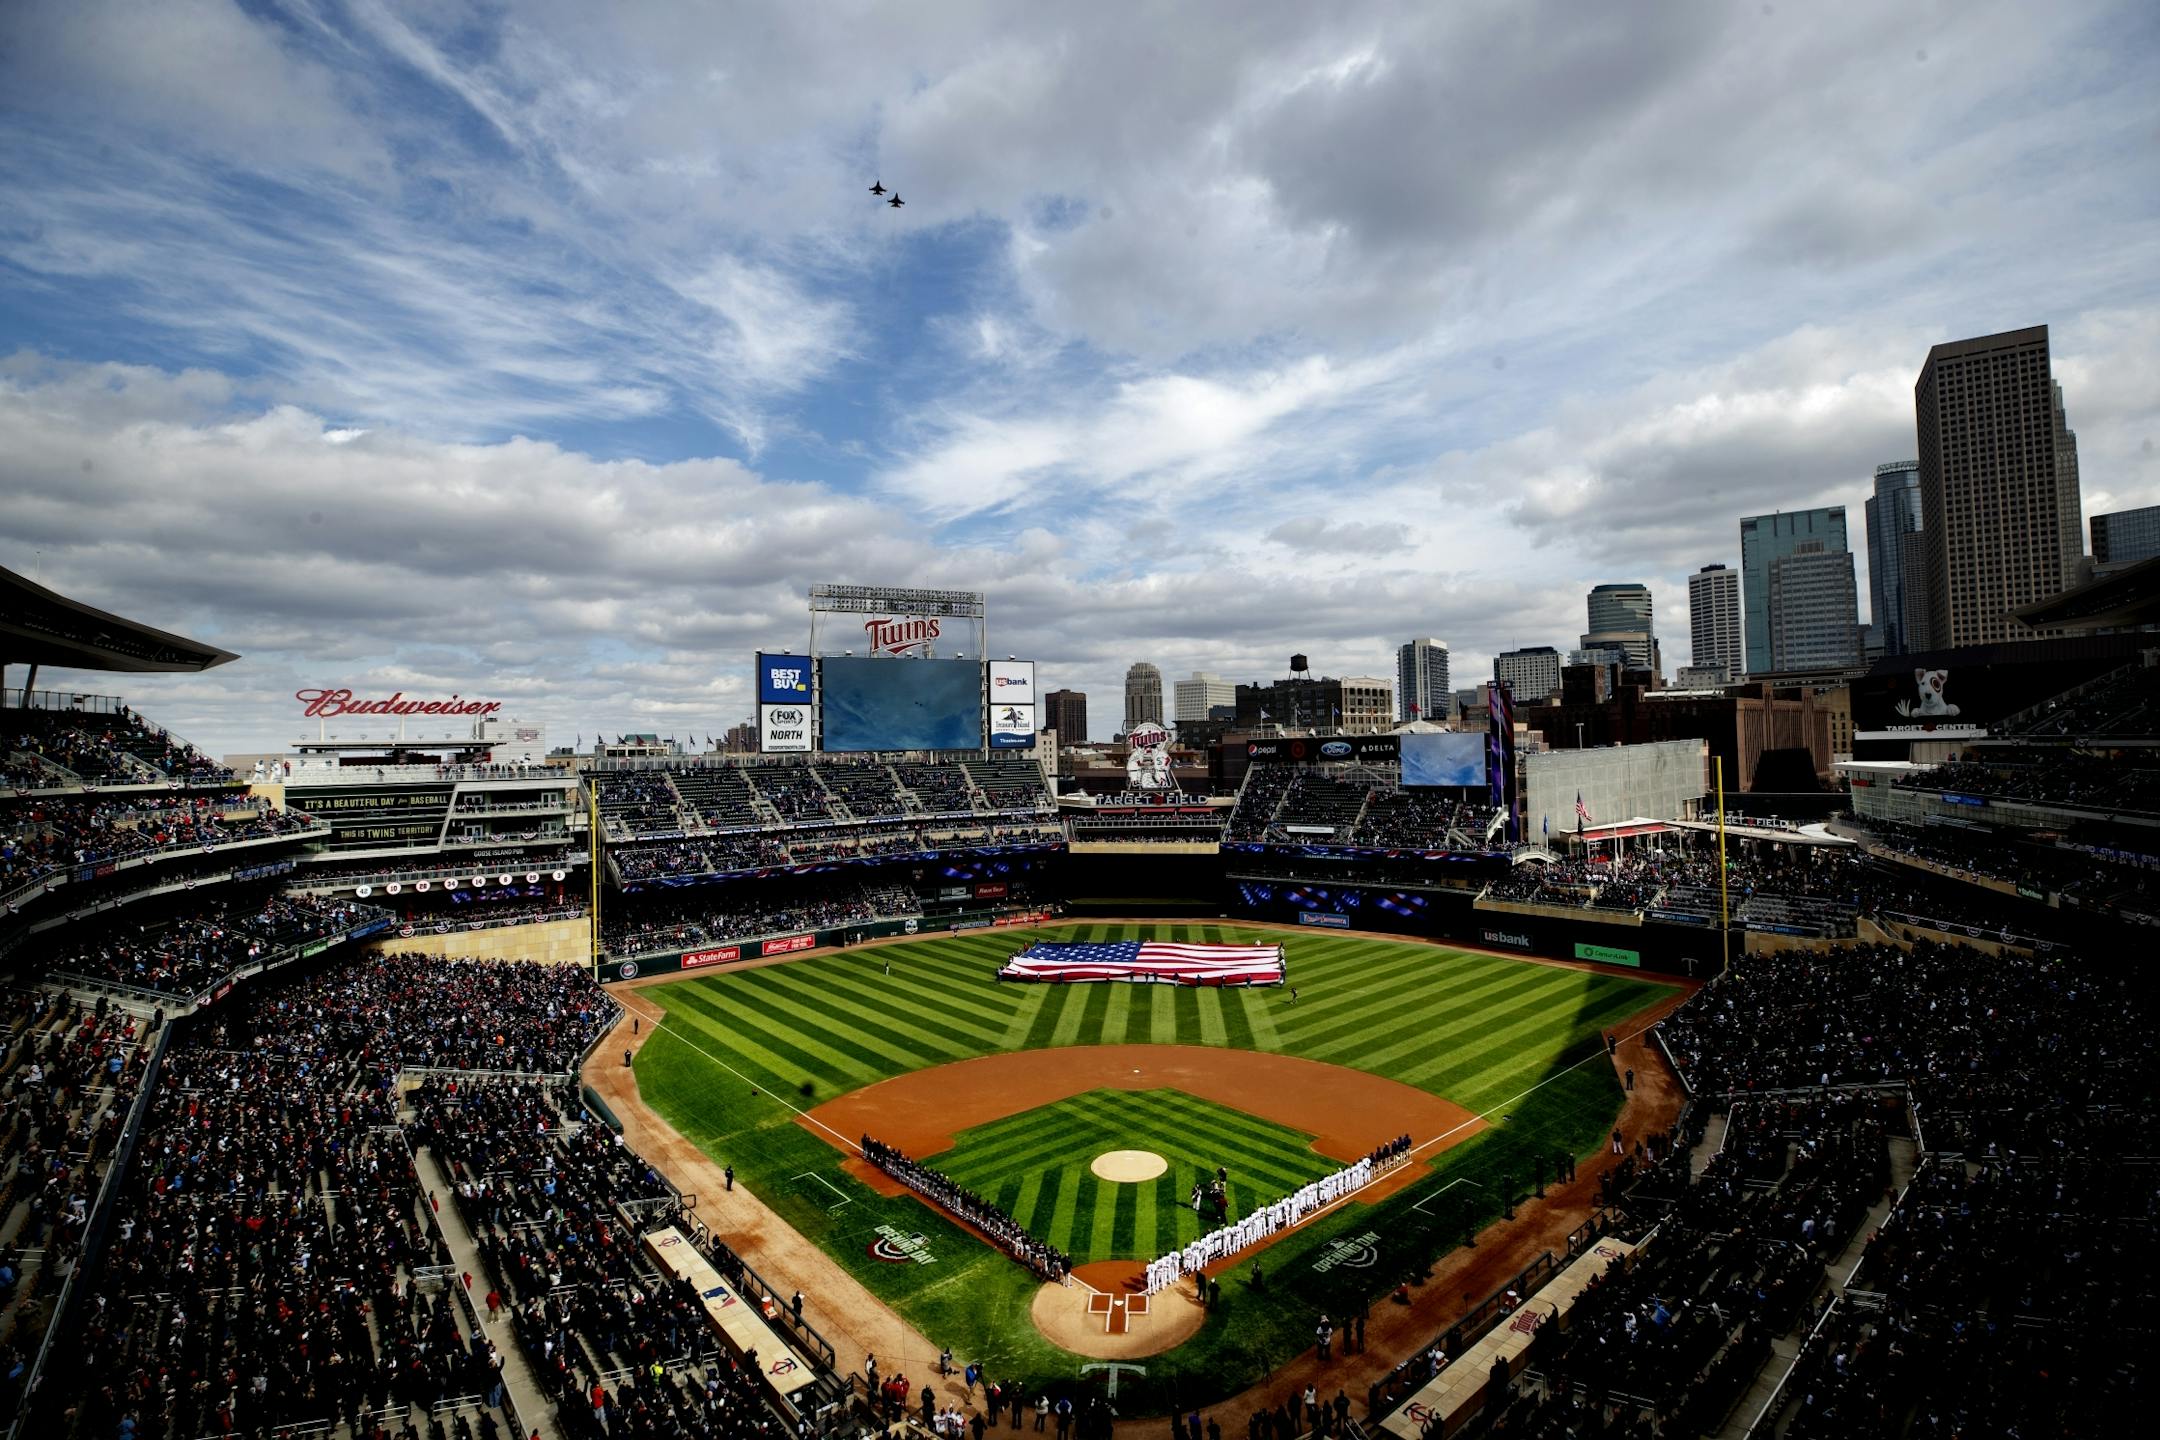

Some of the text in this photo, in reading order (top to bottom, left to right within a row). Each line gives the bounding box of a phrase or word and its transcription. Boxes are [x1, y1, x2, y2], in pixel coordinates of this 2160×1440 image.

[864, 615, 942, 654] Twins
[770, 668, 802, 680] BEST
[773, 679, 798, 690] BUY
[296, 688, 502, 718] Budweiser
[776, 710, 797, 720] FOX
[1885, 723, 1977, 732] TARGET CENTER
[770, 730, 803, 740] NORTH
[1127, 730, 1168, 749] Twins
[1257, 745, 1277, 755] pepsi
[1325, 744, 1346, 754] Ford
[1368, 744, 1395, 752] DELTA
[304, 800, 324, 809] IT'S
[325, 800, 332, 808] A
[333, 798, 380, 808] BEAUTIFUL
[380, 797, 395, 806] DAY
[410, 795, 448, 805] BASEBALL
[1096, 793, 1209, 806] TARGET FIELD
[1705, 813, 1789, 828] TAGET FIELD
[341, 826, 434, 839] THIS IS TWINS TERRITORY
[1483, 930, 1530, 947] usbank
[873, 1224, 939, 1265] OPENING DAY
[1311, 1230, 1382, 1273] OPENING DAY
[1509, 1309, 1538, 1335] Twins
